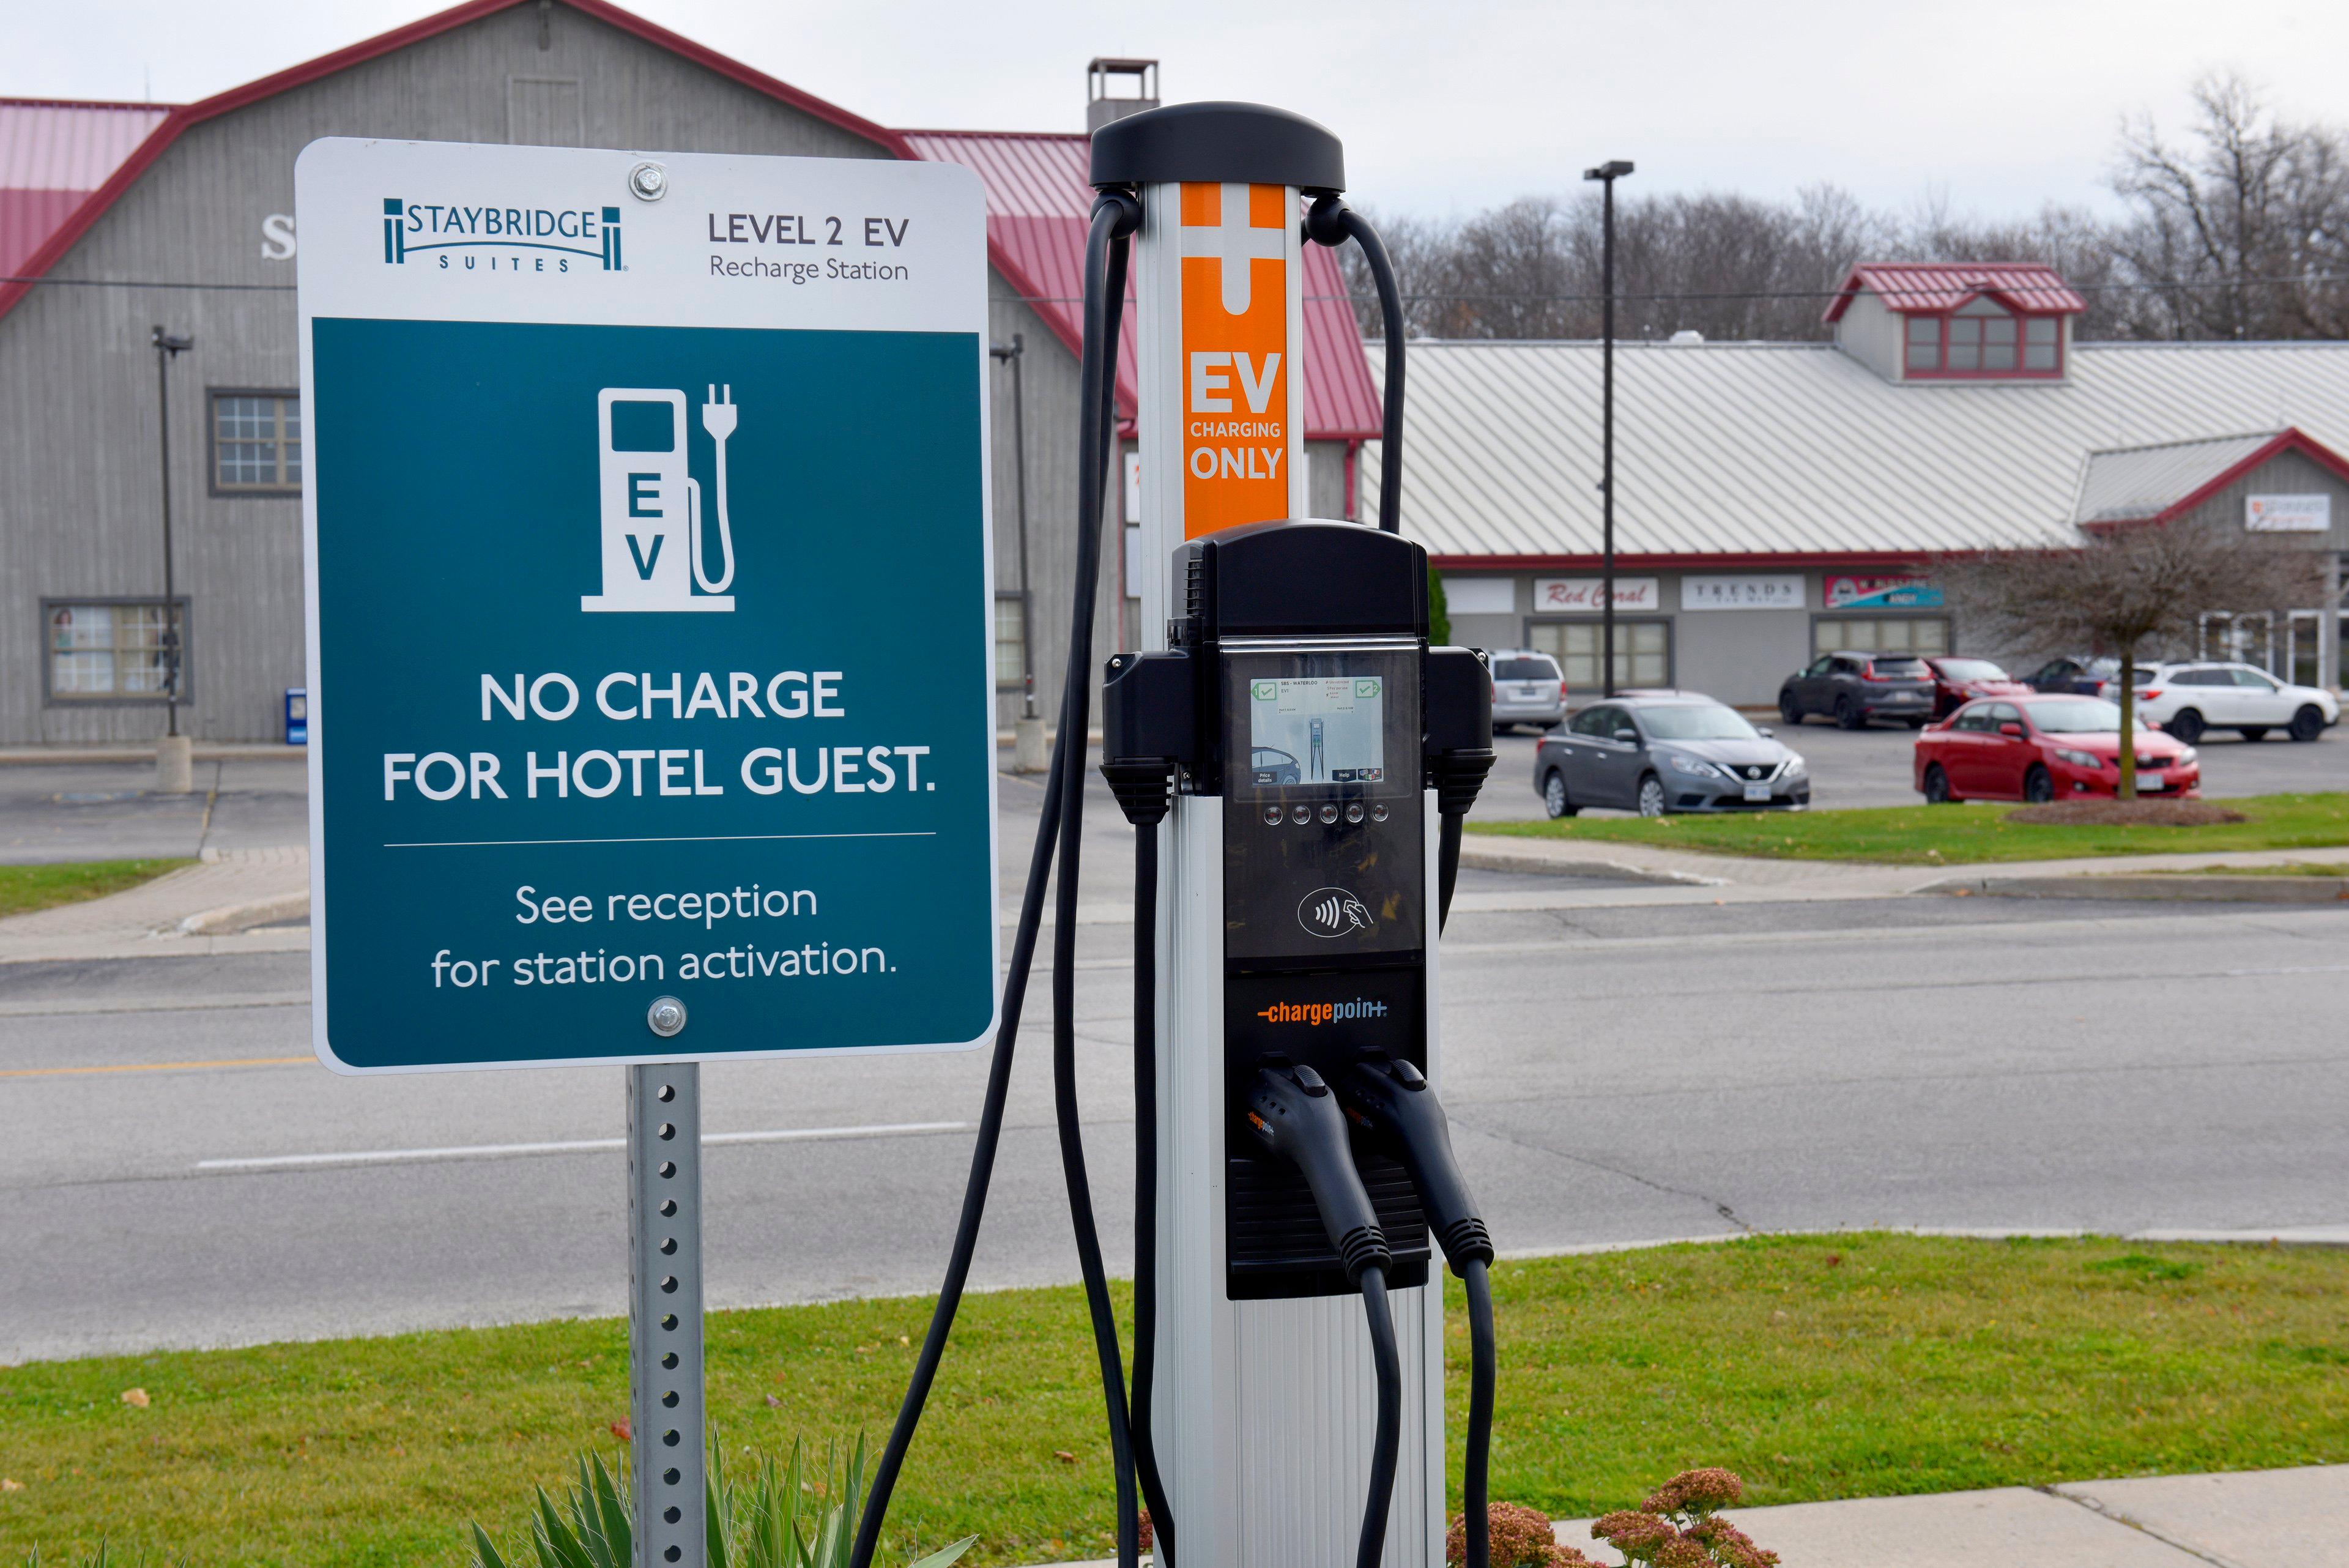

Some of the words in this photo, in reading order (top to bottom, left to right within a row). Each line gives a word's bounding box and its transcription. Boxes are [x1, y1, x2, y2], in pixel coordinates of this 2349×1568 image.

[407, 204, 598, 238] STAYBRIDGE
[708, 213, 817, 245] LEVEL
[825, 216, 843, 246] 2
[864, 217, 910, 247] EV
[439, 255, 569, 273] SUITES
[710, 255, 820, 285] Recharge
[826, 258, 909, 280] Station
[1190, 351, 1282, 414] EV
[1190, 422, 1280, 438] CHARGING
[1190, 447, 1283, 480] ONLY
[1547, 583, 1588, 603] Red
[1592, 582, 1647, 607] Cral
[1695, 583, 1792, 597] TRENDS
[481, 672, 579, 721] NO
[596, 671, 845, 721] CHARGE
[384, 752, 509, 801] FOR
[527, 749, 724, 798] HOTEL
[741, 745, 935, 795] GUEST.
[516, 885, 593, 924] See
[608, 883, 817, 930] reception
[431, 949, 500, 987] for
[513, 948, 664, 986] station
[679, 941, 896, 979] activation.
